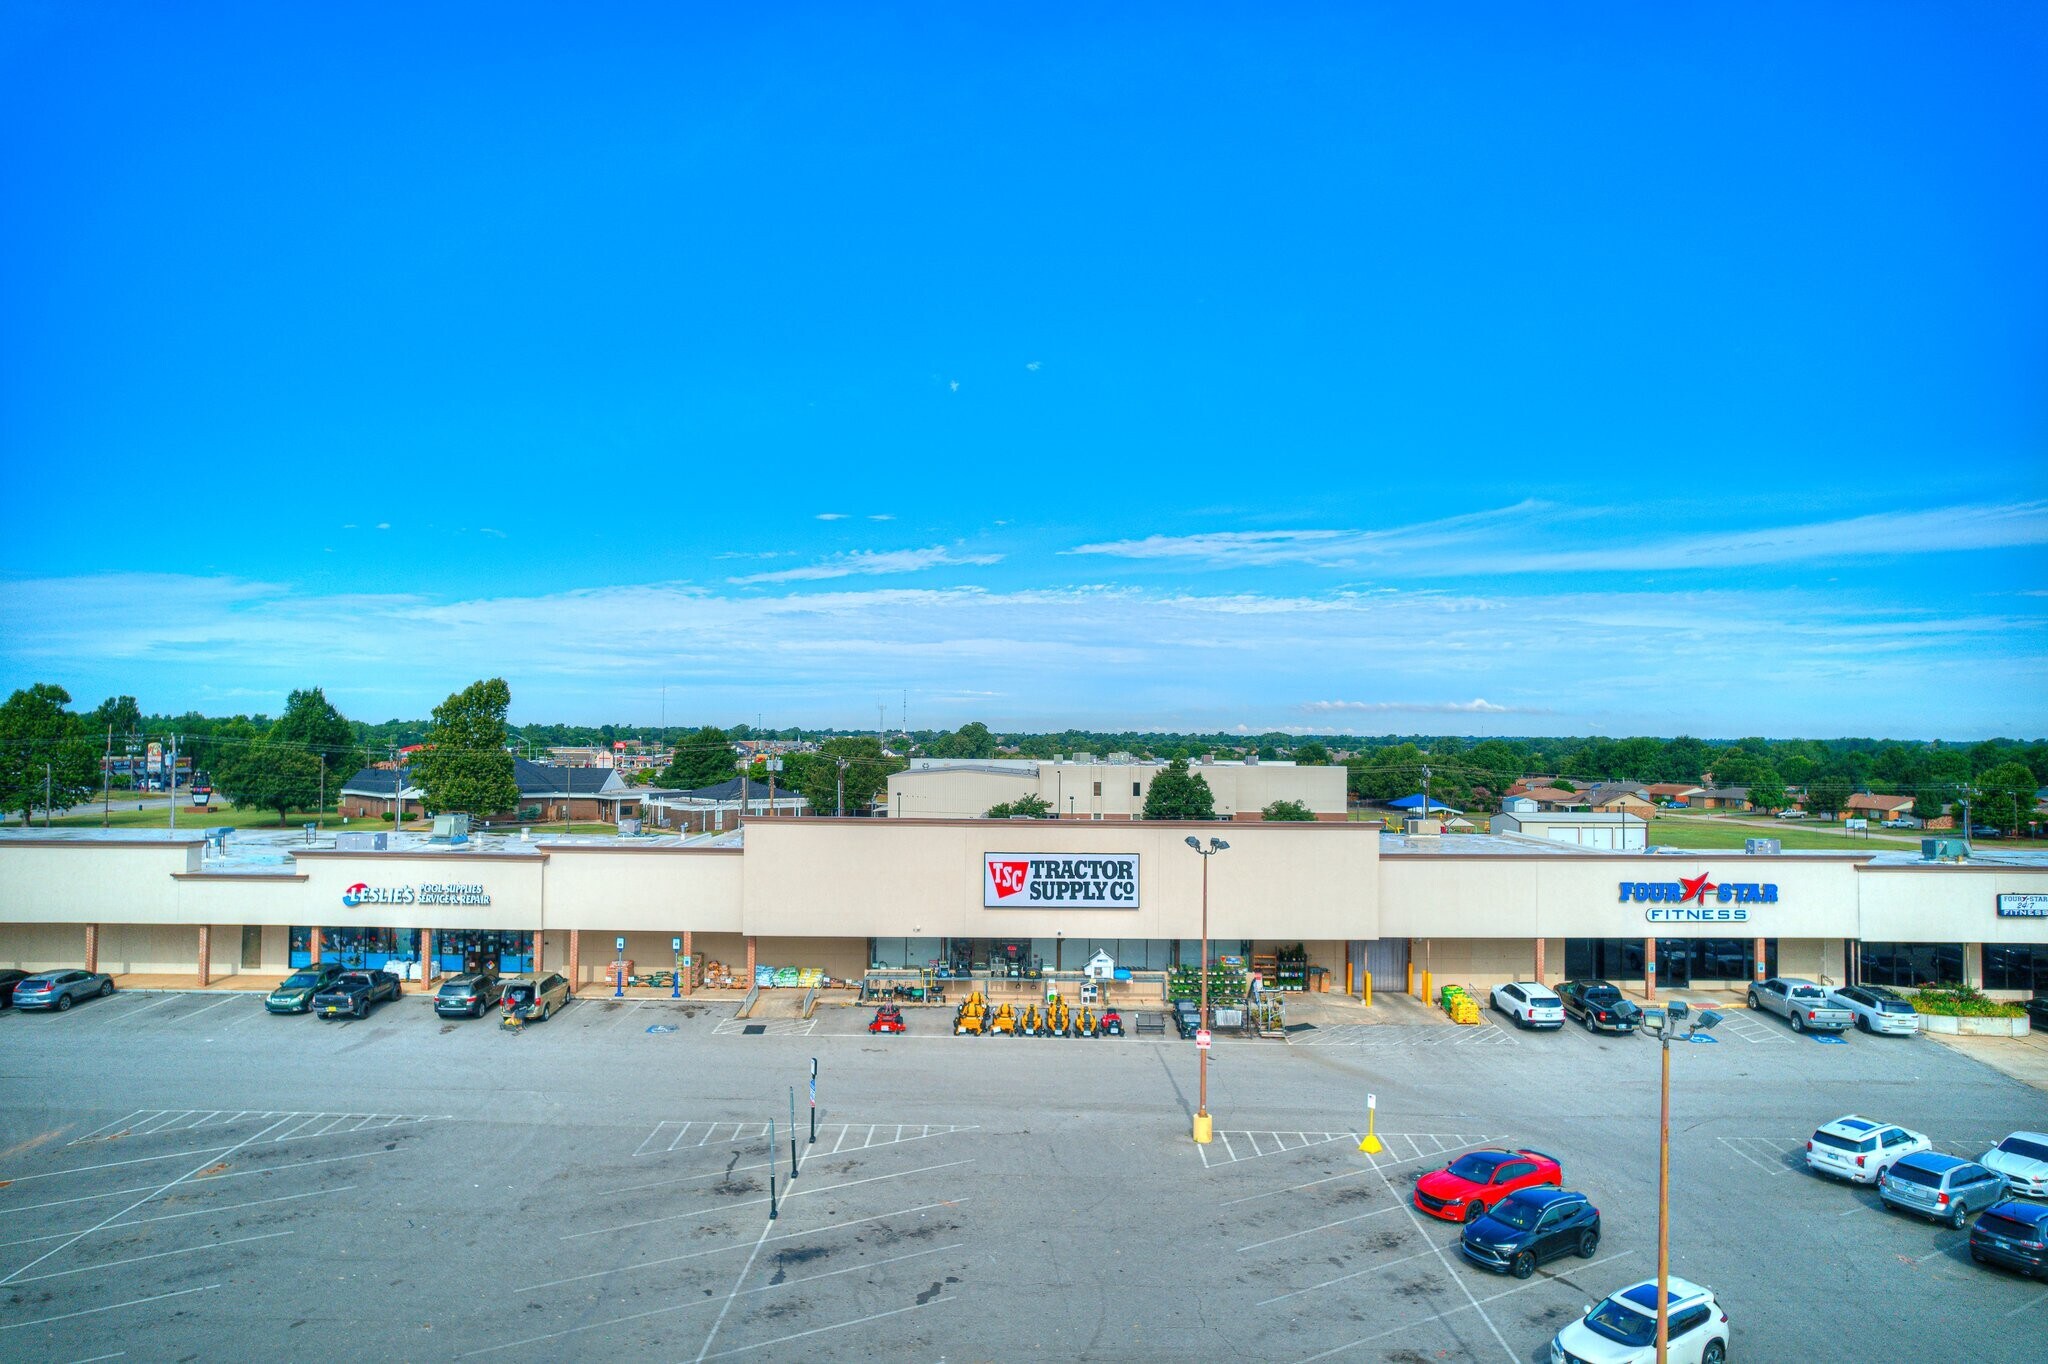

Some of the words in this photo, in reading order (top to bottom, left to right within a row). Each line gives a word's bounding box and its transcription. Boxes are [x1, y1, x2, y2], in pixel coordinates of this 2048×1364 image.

[993, 862, 1023, 892] TSC
[1030, 860, 1134, 879] TRACTOR
[350, 885, 415, 904] LESLIE'S
[419, 884, 444, 893] POOL
[445, 884, 483, 894] SUPPLIES
[1030, 881, 1108, 900] SUPPLY
[1618, 882, 1681, 903] FOUR
[1716, 883, 1779, 903] STAR
[417, 894, 450, 904] SERVICE
[450, 895, 459, 904] &
[460, 895, 491, 905] REPAIR
[1651, 909, 1747, 920] FITNESS
